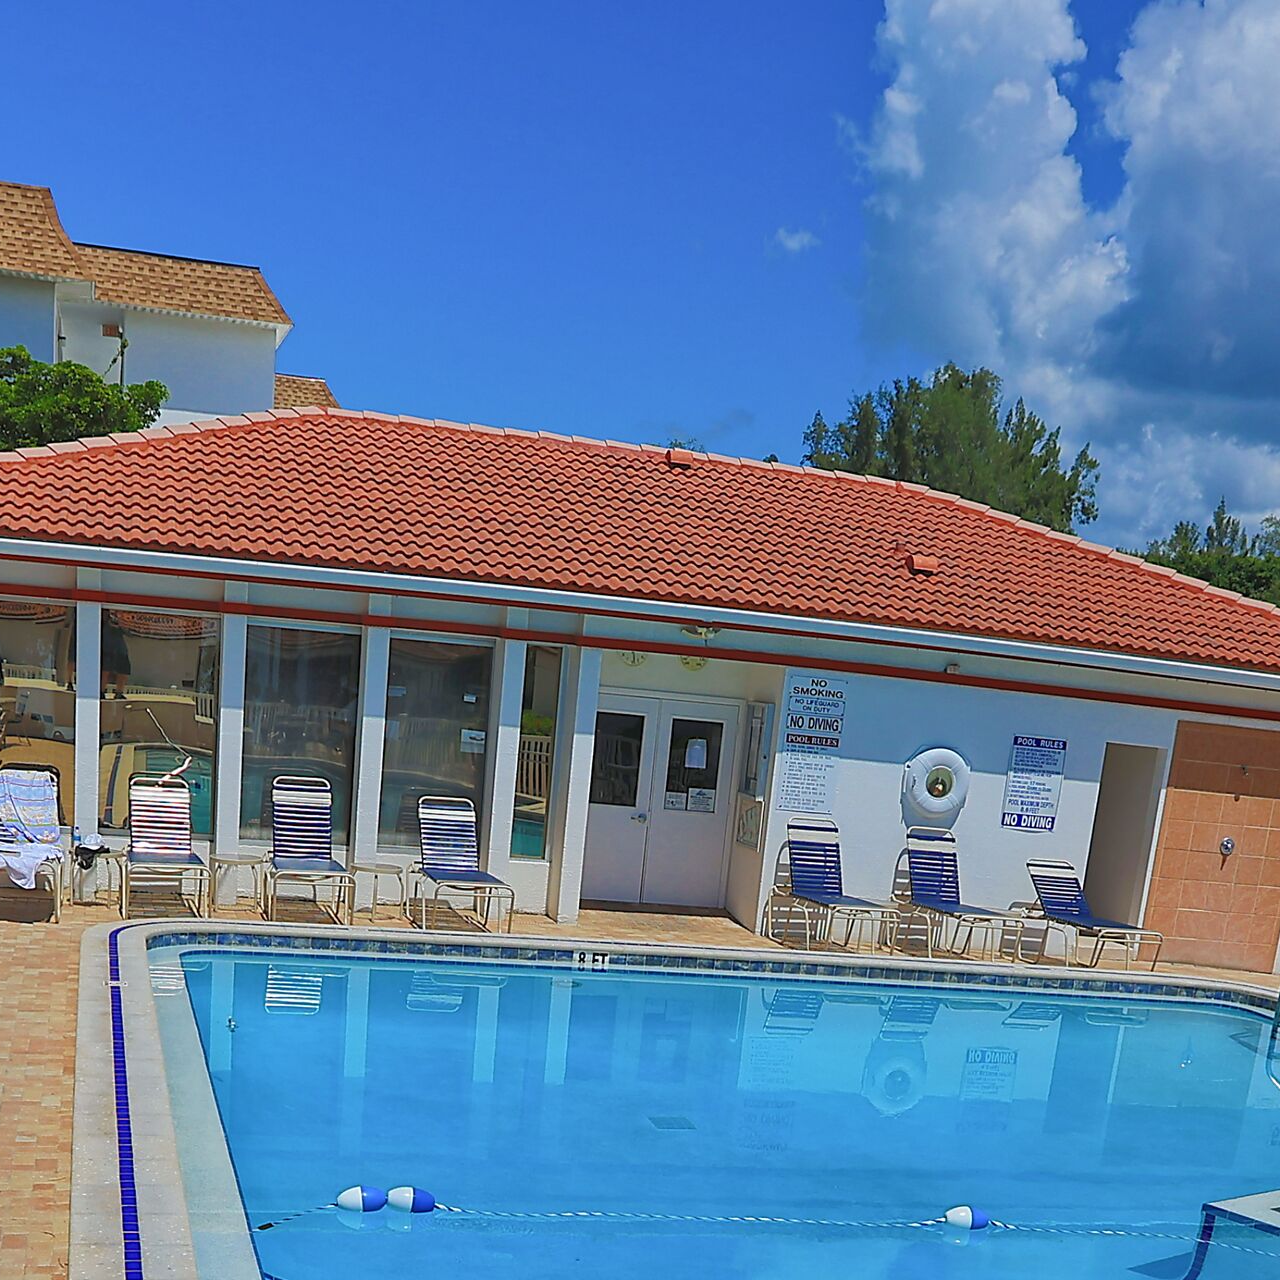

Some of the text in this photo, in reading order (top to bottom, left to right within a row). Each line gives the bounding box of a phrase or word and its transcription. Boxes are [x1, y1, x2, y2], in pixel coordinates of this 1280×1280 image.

[811, 679, 828, 688] NO
[793, 686, 844, 699] SMOKING
[806, 700, 840, 709] LIFEGUARD
[789, 715, 840, 732] NO DIVING
[788, 735, 837, 747] POOL RULES
[1017, 737, 1064, 749] POOL RULES
[1003, 813, 1053, 829] NO DIVING
[591, 952, 609, 964] FT
